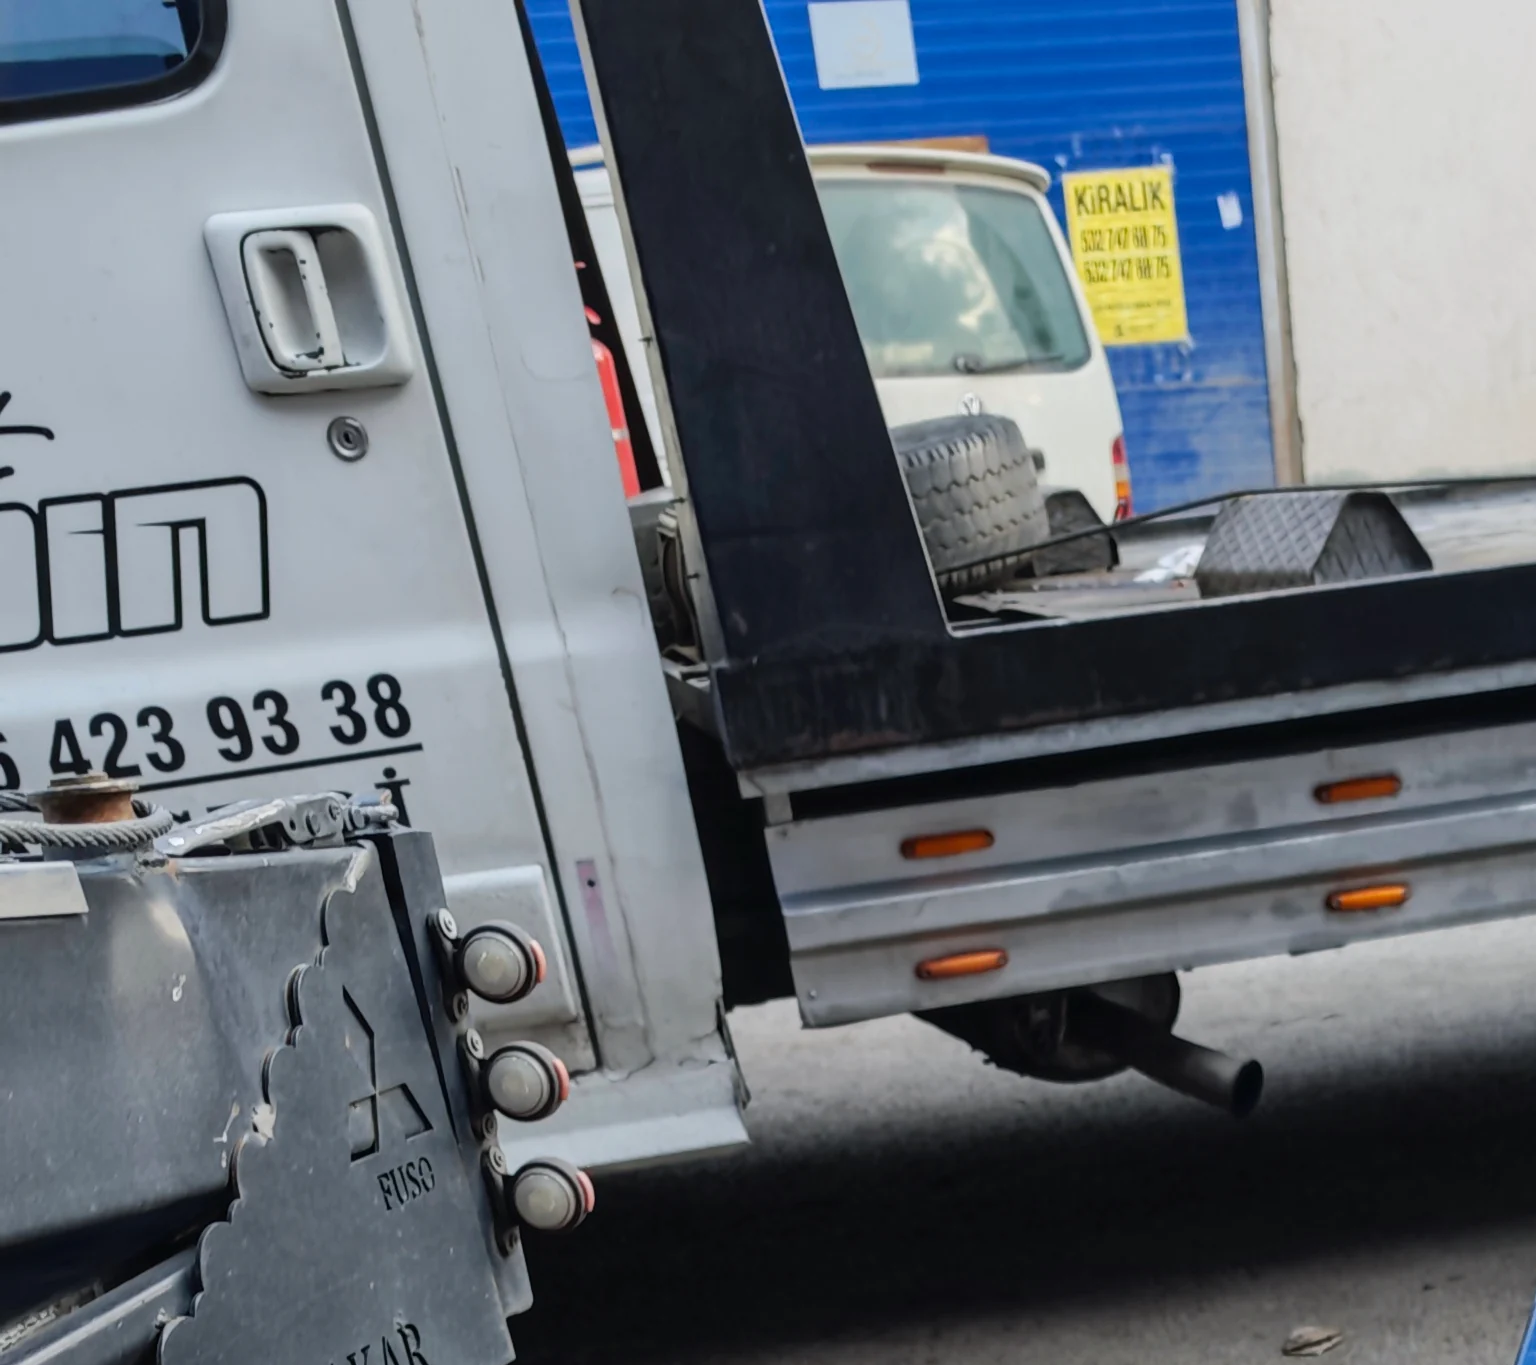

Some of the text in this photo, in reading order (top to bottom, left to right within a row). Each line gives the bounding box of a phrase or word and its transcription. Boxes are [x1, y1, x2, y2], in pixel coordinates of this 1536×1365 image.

[49, 706, 186, 778] 423
[206, 689, 300, 762] 93
[320, 673, 412, 745] 38
[376, 1156, 437, 1211] FUSO
